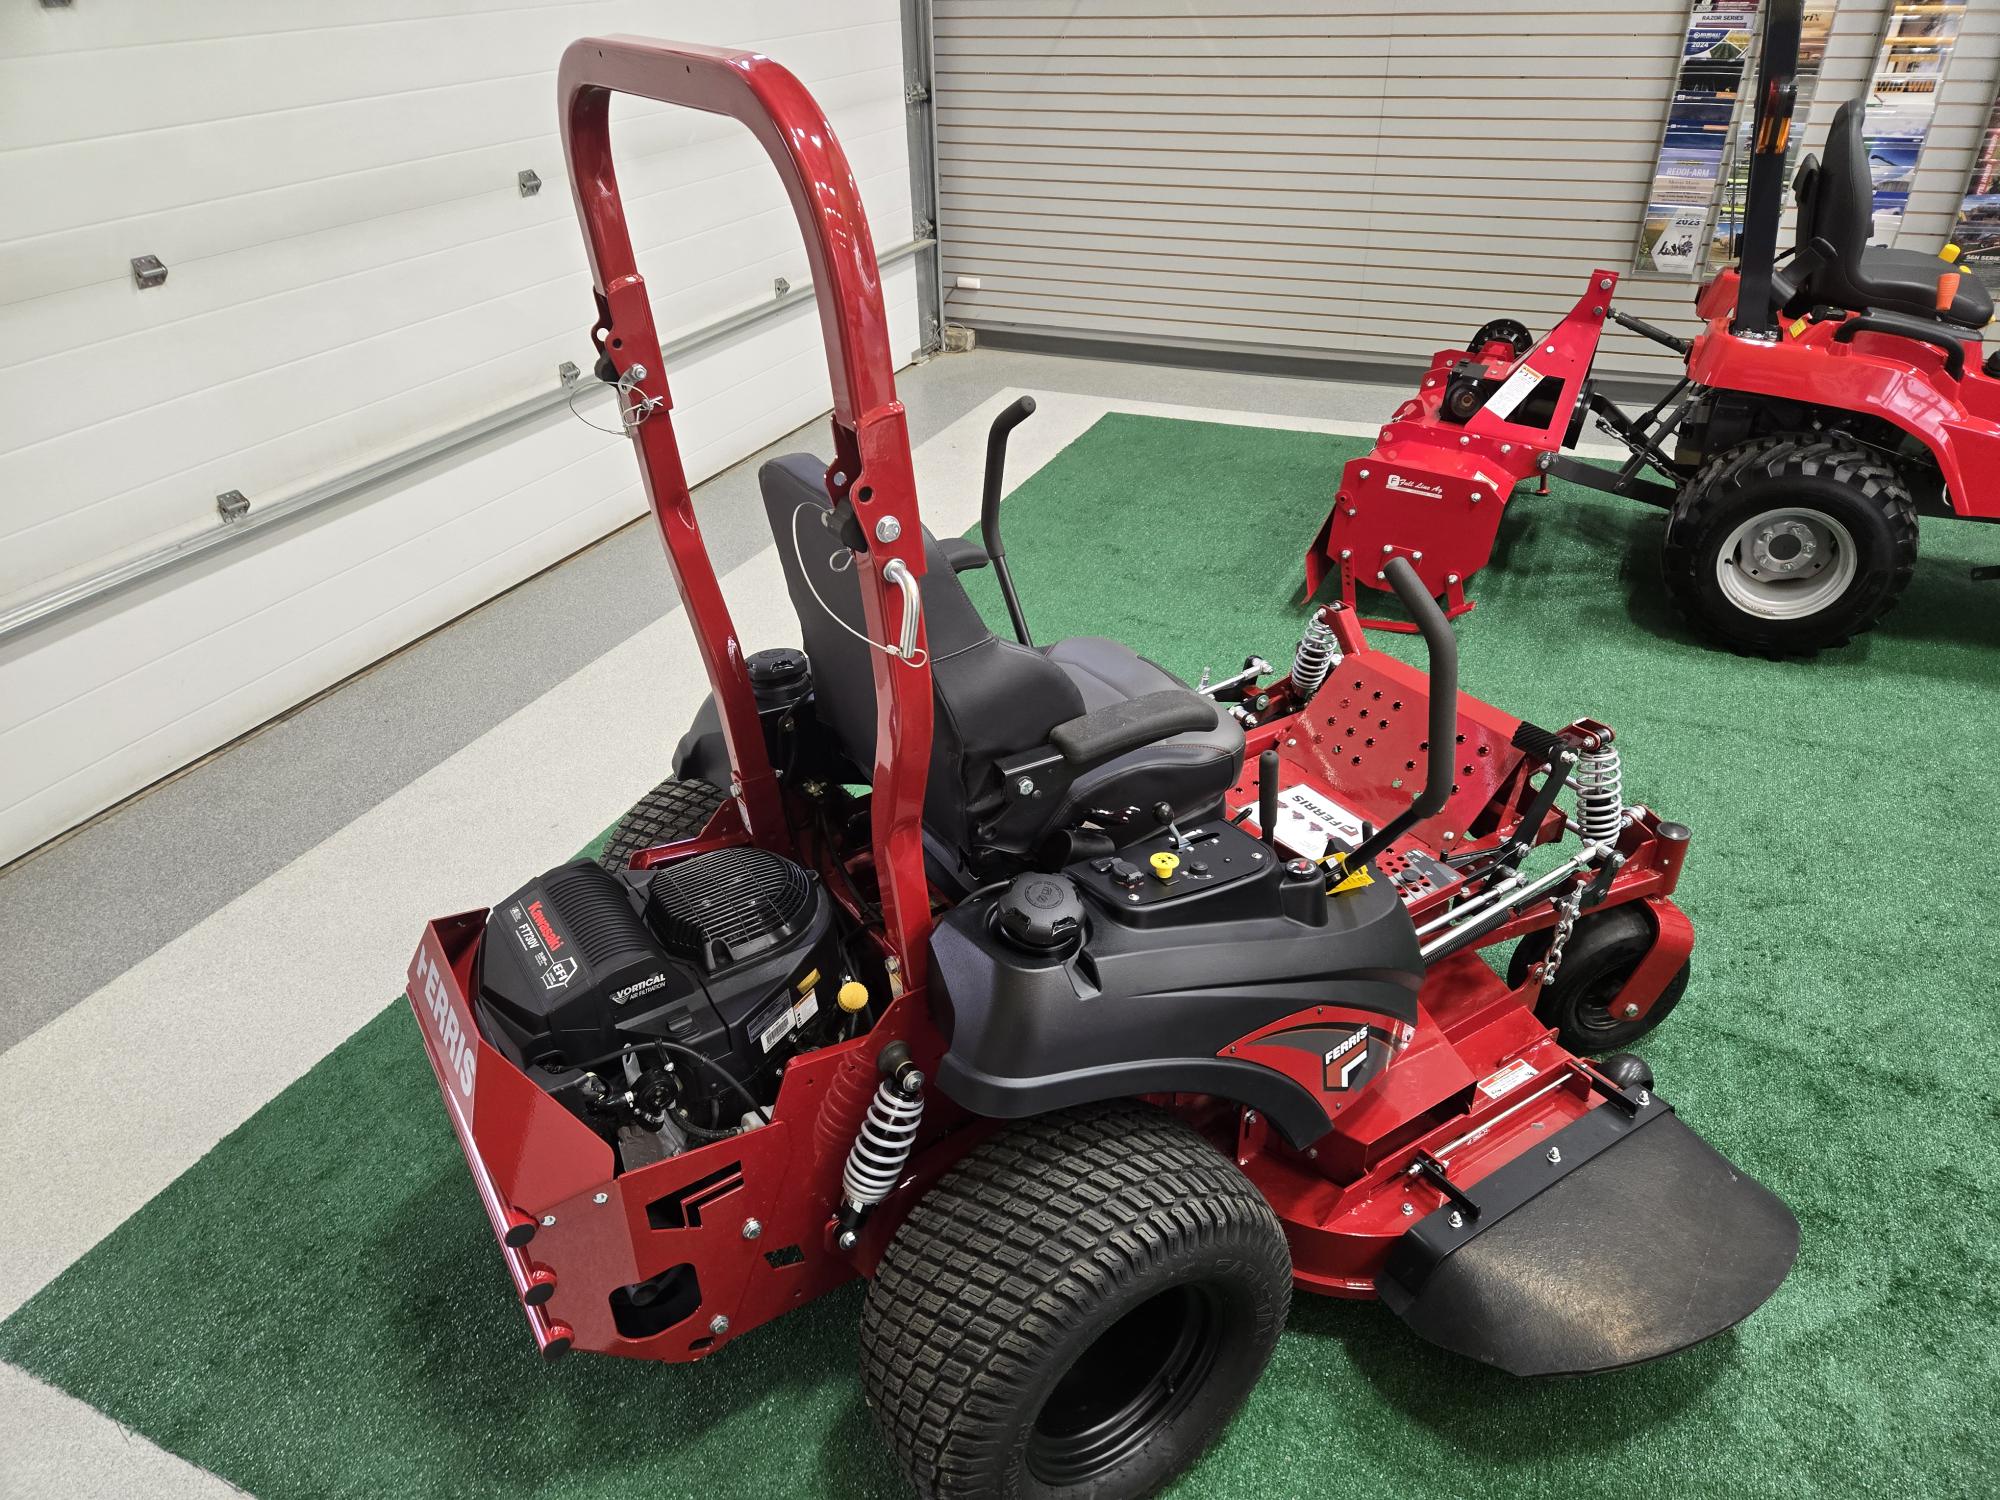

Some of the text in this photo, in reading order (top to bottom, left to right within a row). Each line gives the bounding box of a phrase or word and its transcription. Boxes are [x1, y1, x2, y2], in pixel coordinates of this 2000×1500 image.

[1676, 218, 1700, 226] 2023
[1415, 482, 1431, 490] Line
[1291, 795, 1342, 826] FERRIS
[518, 922, 540, 949] FT730V
[528, 900, 564, 952] Kawasaki
[552, 963, 569, 982] EFI
[616, 973, 666, 999] VORTICAL
[638, 982, 666, 997] FILTRATION
[416, 944, 475, 1097] FERRIS
[1325, 1026, 1368, 1065] FERRIS
